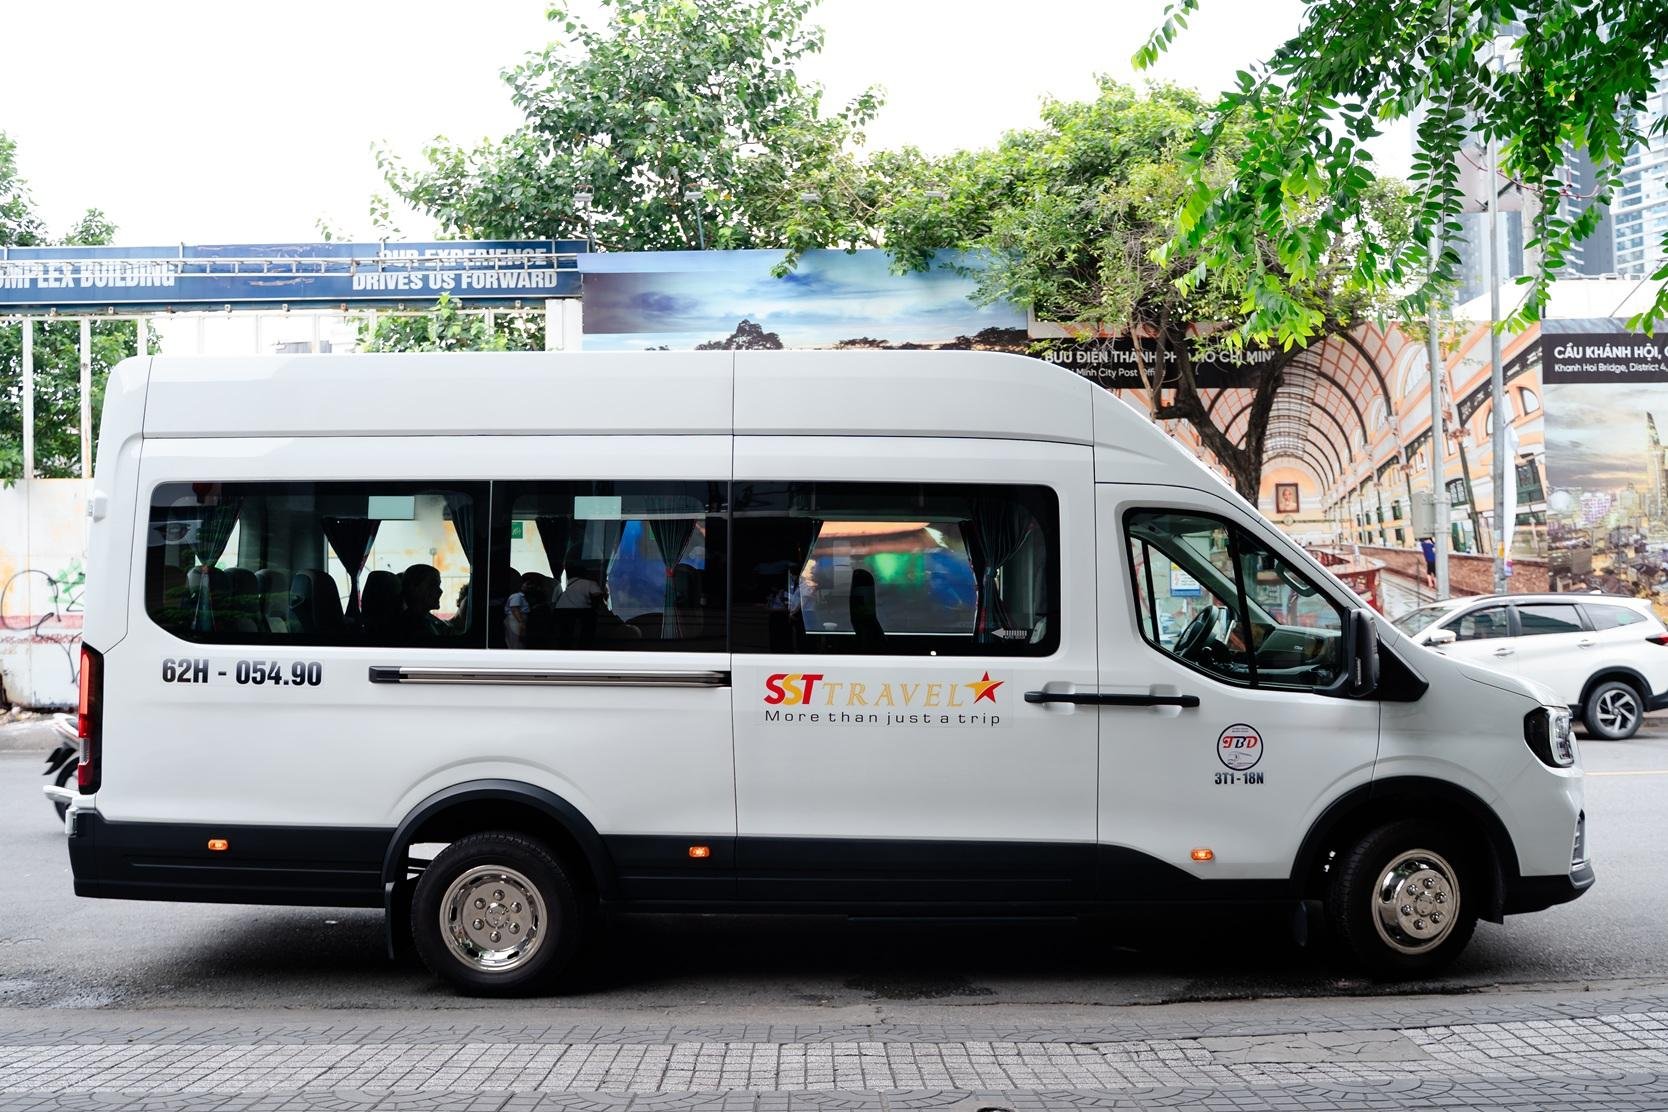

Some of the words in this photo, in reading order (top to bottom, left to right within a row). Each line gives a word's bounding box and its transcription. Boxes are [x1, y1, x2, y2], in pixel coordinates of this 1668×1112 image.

[424, 249, 547, 265] EXPERIENCE
[80, 261, 175, 287] BUILDING
[352, 271, 423, 290] DRIVES
[429, 270, 456, 289] US
[461, 270, 557, 288] FORWARD
[1585, 343, 1632, 359] KHÁNH
[1634, 343, 1662, 361] HỘI,
[1098, 368, 1117, 380] City
[1118, 368, 1138, 377] Post
[1554, 363, 1582, 373] Khanh
[1598, 363, 1628, 374] Bridge,
[1629, 362, 1660, 372] District
[162, 658, 209, 683] 62H
[236, 660, 322, 686] 054.90
[764, 674, 824, 705] SST
[823, 682, 964, 707] TRAVEL
[765, 710, 820, 722] More
[829, 711, 878, 723] than
[887, 712, 931, 725] just
[940, 714, 949, 724] a
[958, 713, 1000, 726] trip
